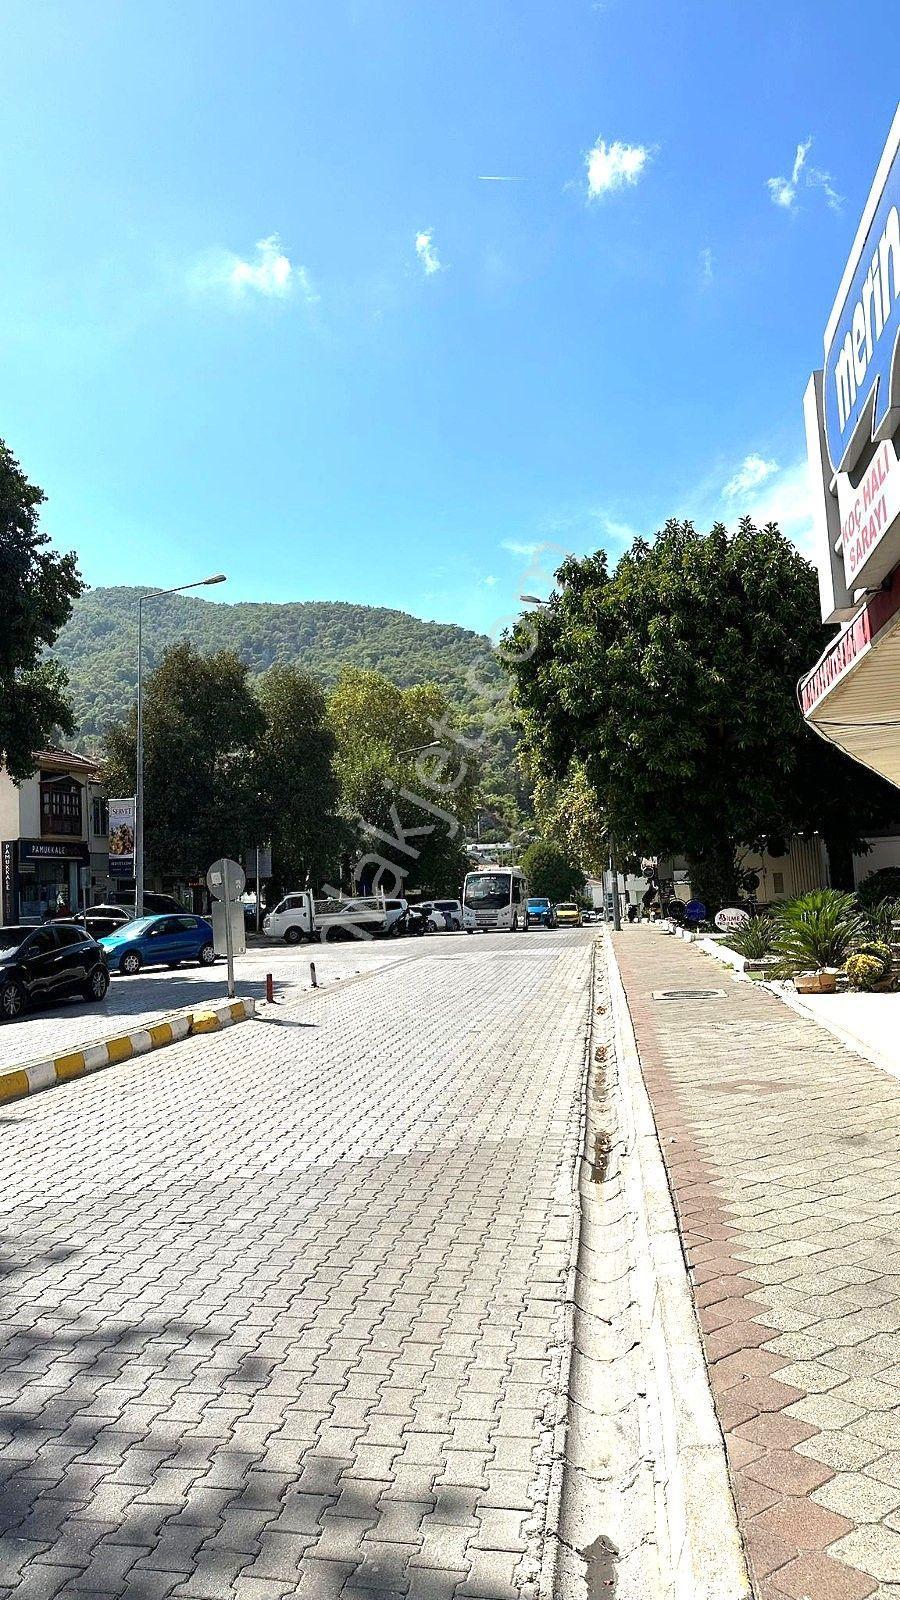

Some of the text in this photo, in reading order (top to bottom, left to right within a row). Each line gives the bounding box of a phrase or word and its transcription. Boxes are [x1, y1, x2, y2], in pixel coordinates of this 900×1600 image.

[842, 444, 889, 548] KOÇ HALI
[850, 494, 887, 572] SARAYI
[31, 845, 65, 855] PAMUKKALE
